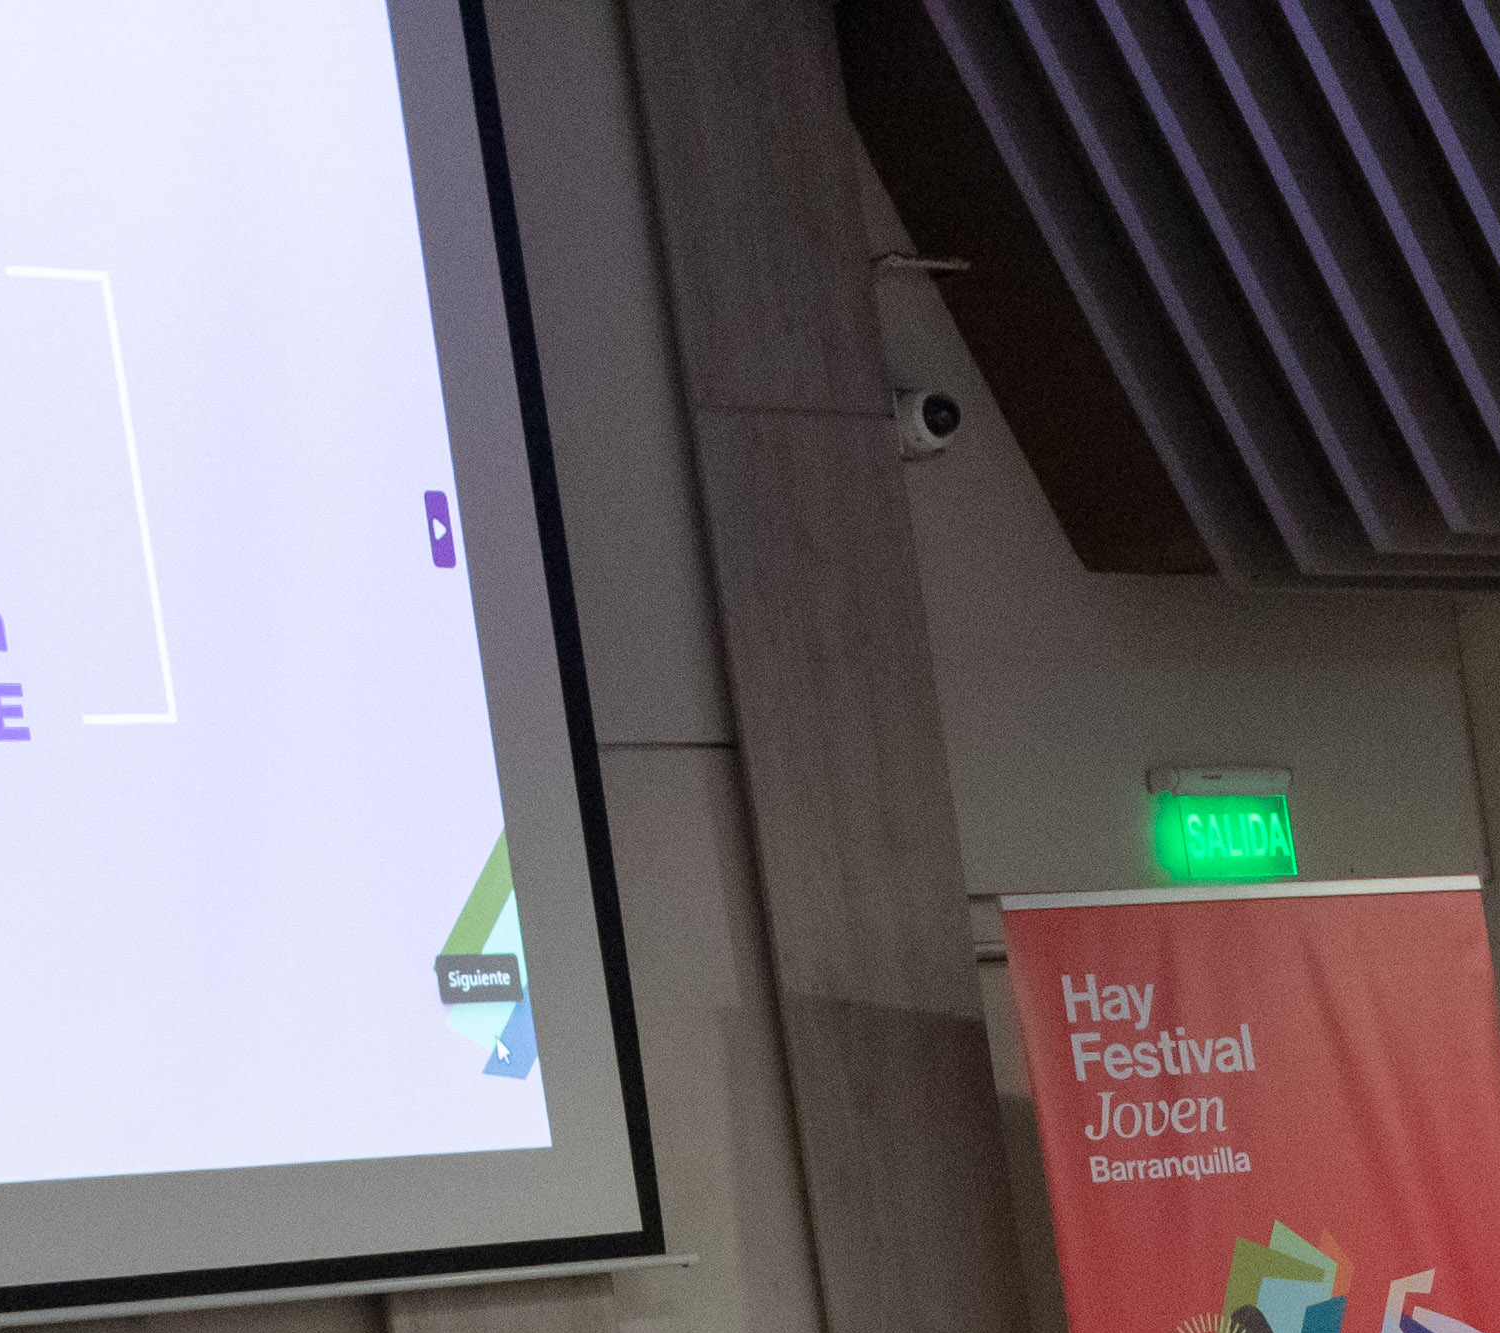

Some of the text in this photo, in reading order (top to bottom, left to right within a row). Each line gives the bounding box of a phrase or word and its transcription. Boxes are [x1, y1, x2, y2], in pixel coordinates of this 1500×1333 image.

[1187, 812, 1291, 859] SALIDA
[448, 969, 511, 993] Siguiente
[1061, 973, 1154, 1030] Hay
[1070, 1023, 1256, 1082] Festival
[1084, 1091, 1227, 1141] Joven
[1089, 1146, 1251, 1183] Barranquilla
